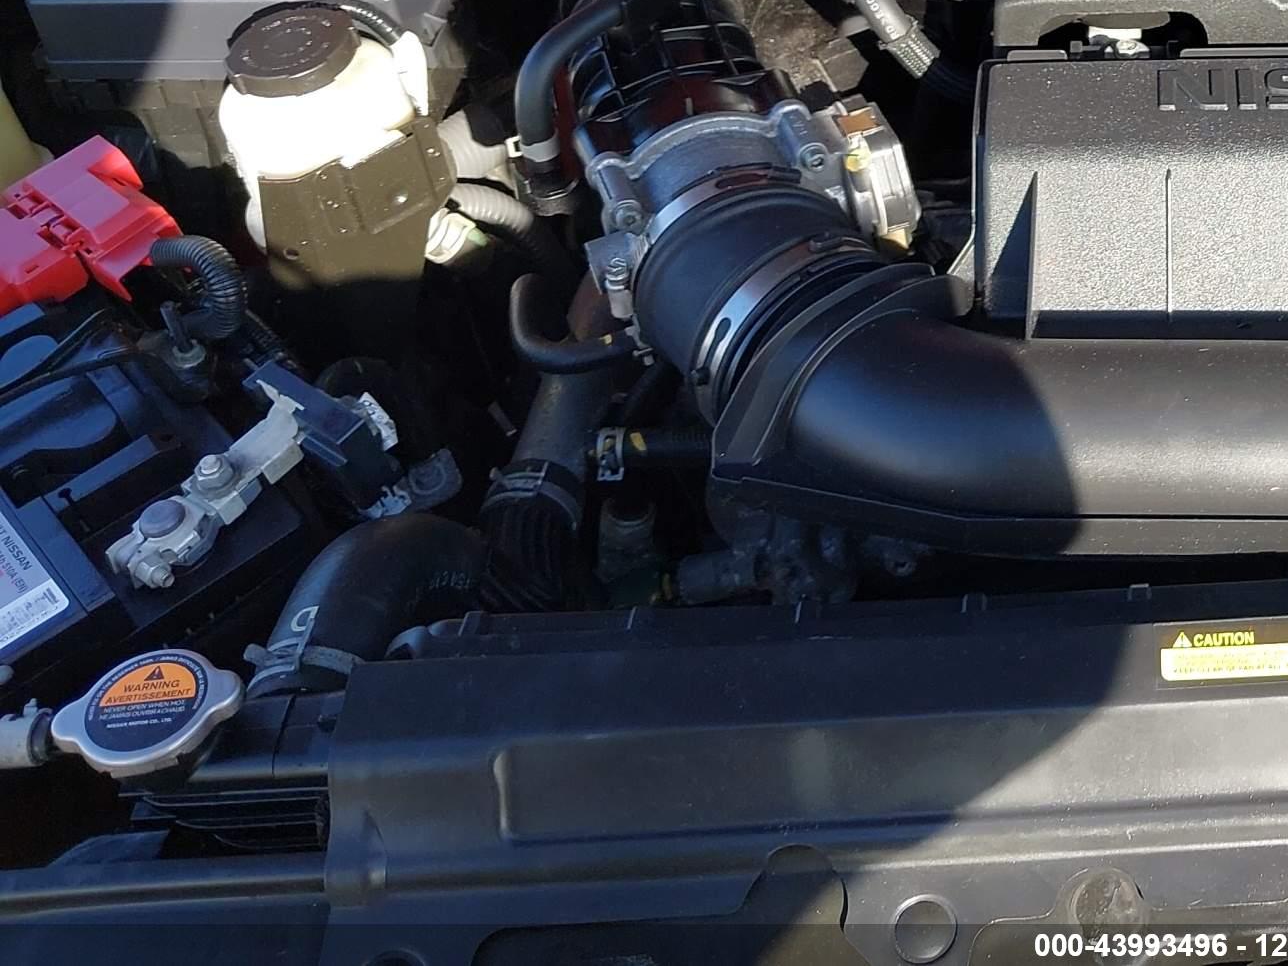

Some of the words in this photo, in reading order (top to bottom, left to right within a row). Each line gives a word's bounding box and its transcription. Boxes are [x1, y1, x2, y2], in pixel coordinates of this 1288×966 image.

[2, 535, 32, 571] NISSAN
[1193, 631, 1255, 647] CAUTION
[124, 679, 180, 693] WARNING
[105, 688, 192, 705] AVERTISSEMENT
[104, 704, 127, 713] NEVER
[128, 703, 148, 712] OPEN
[148, 701, 170, 710] WHEN
